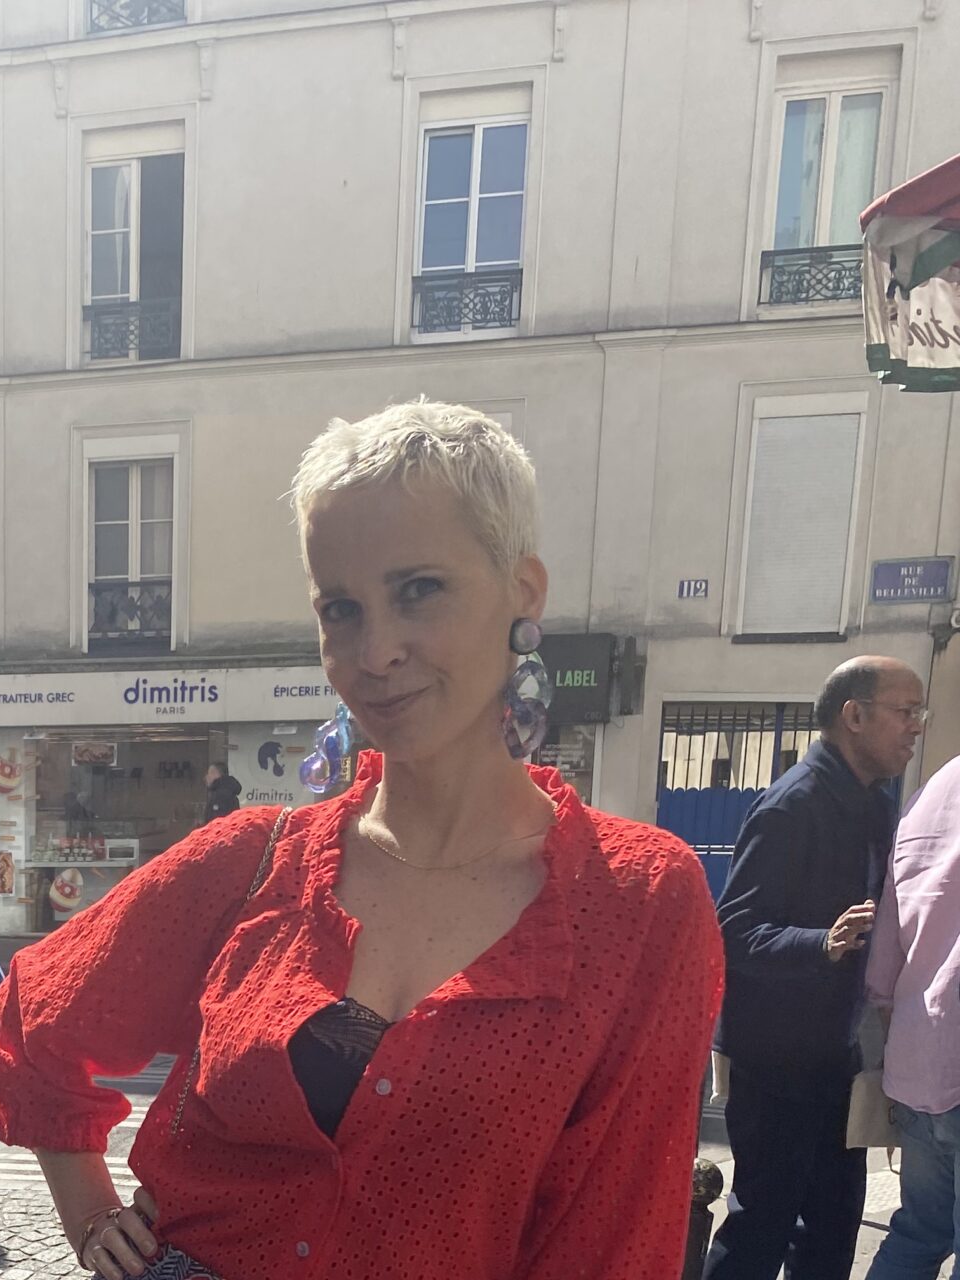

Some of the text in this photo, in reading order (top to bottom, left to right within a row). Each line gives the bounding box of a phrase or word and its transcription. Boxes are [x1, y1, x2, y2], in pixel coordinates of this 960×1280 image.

[900, 566, 924, 576] RUE
[904, 576, 919, 586] DE
[682, 580, 706, 598] 112
[875, 586, 944, 597] BELLEVILLE
[555, 669, 598, 688] LABEL
[46, 691, 75, 703] GREC
[123, 677, 219, 705] dimitris
[273, 684, 321, 698] ÉPICERIE
[155, 706, 186, 715] PARIS
[246, 789, 294, 801] dimitris
